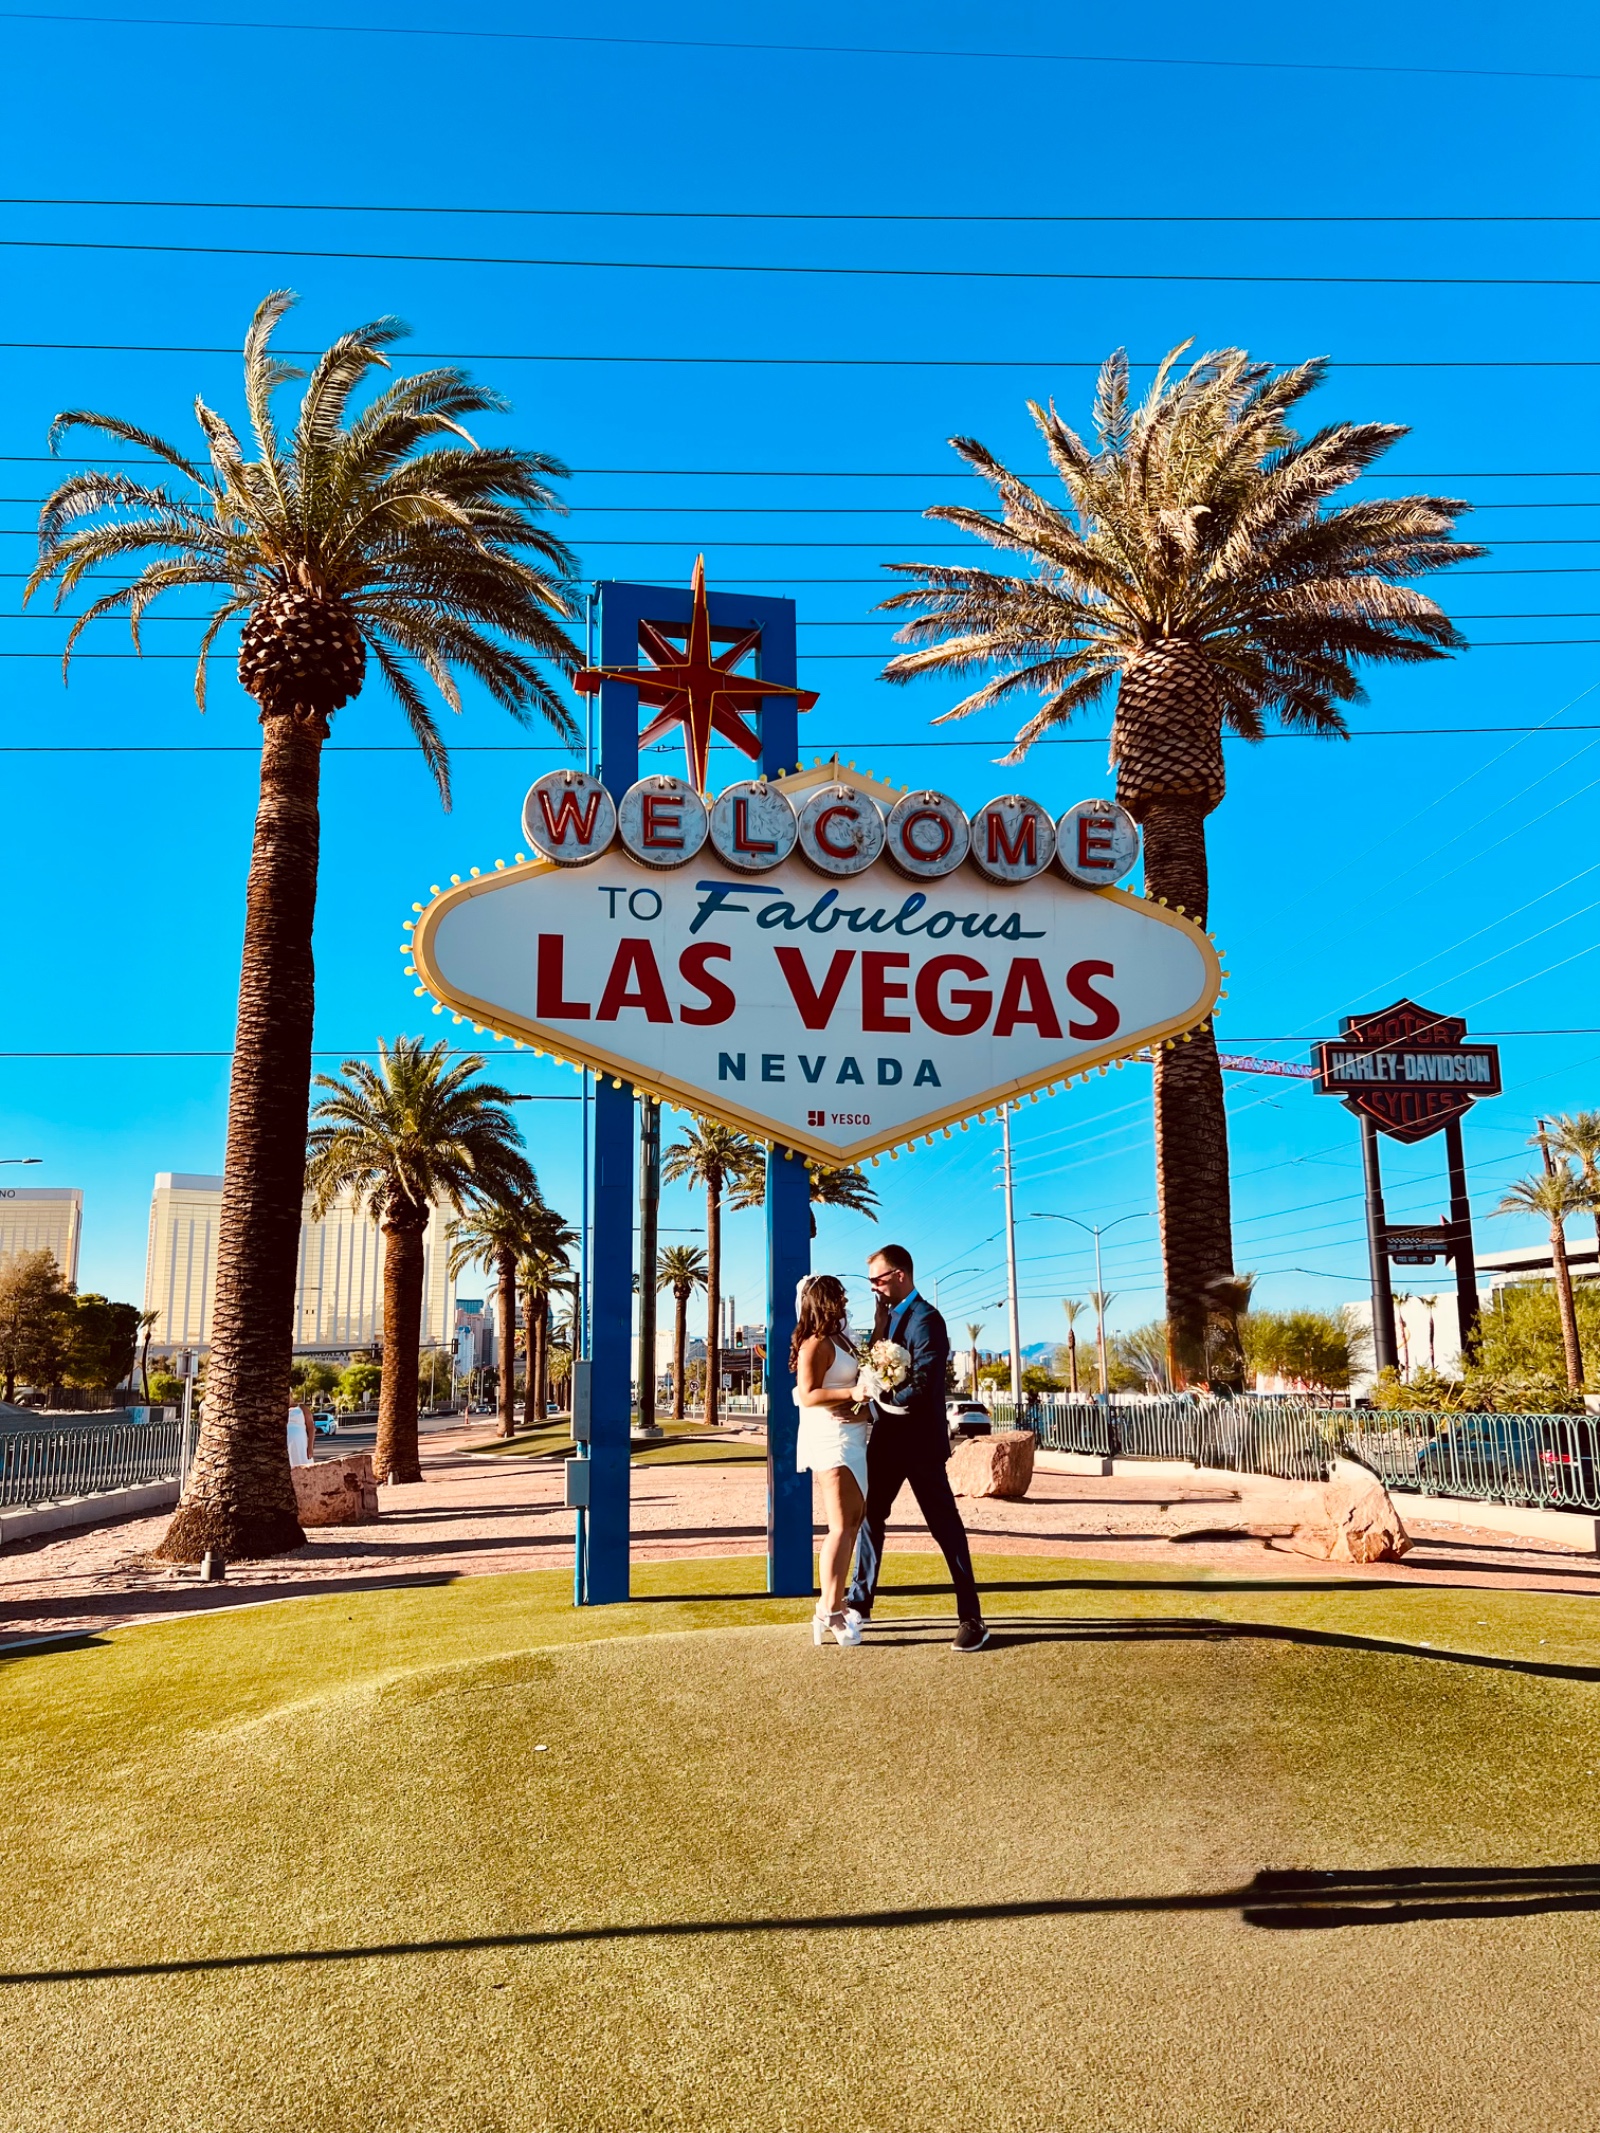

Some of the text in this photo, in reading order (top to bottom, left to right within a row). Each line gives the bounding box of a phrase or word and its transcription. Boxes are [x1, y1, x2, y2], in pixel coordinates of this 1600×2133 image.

[537, 789, 1116, 869] WELCOME
[598, 880, 1047, 940] TO Fabulous
[536, 933, 1120, 1041] LAS VEGAS
[1367, 1012, 1450, 1043] MOTOR
[718, 1052, 942, 1088] NEVADA
[1332, 1053, 1490, 1082] HARLEY-DAVIDSON
[831, 1113, 871, 1126] YESCO
[1372, 1091, 1454, 1126] CYCLES
